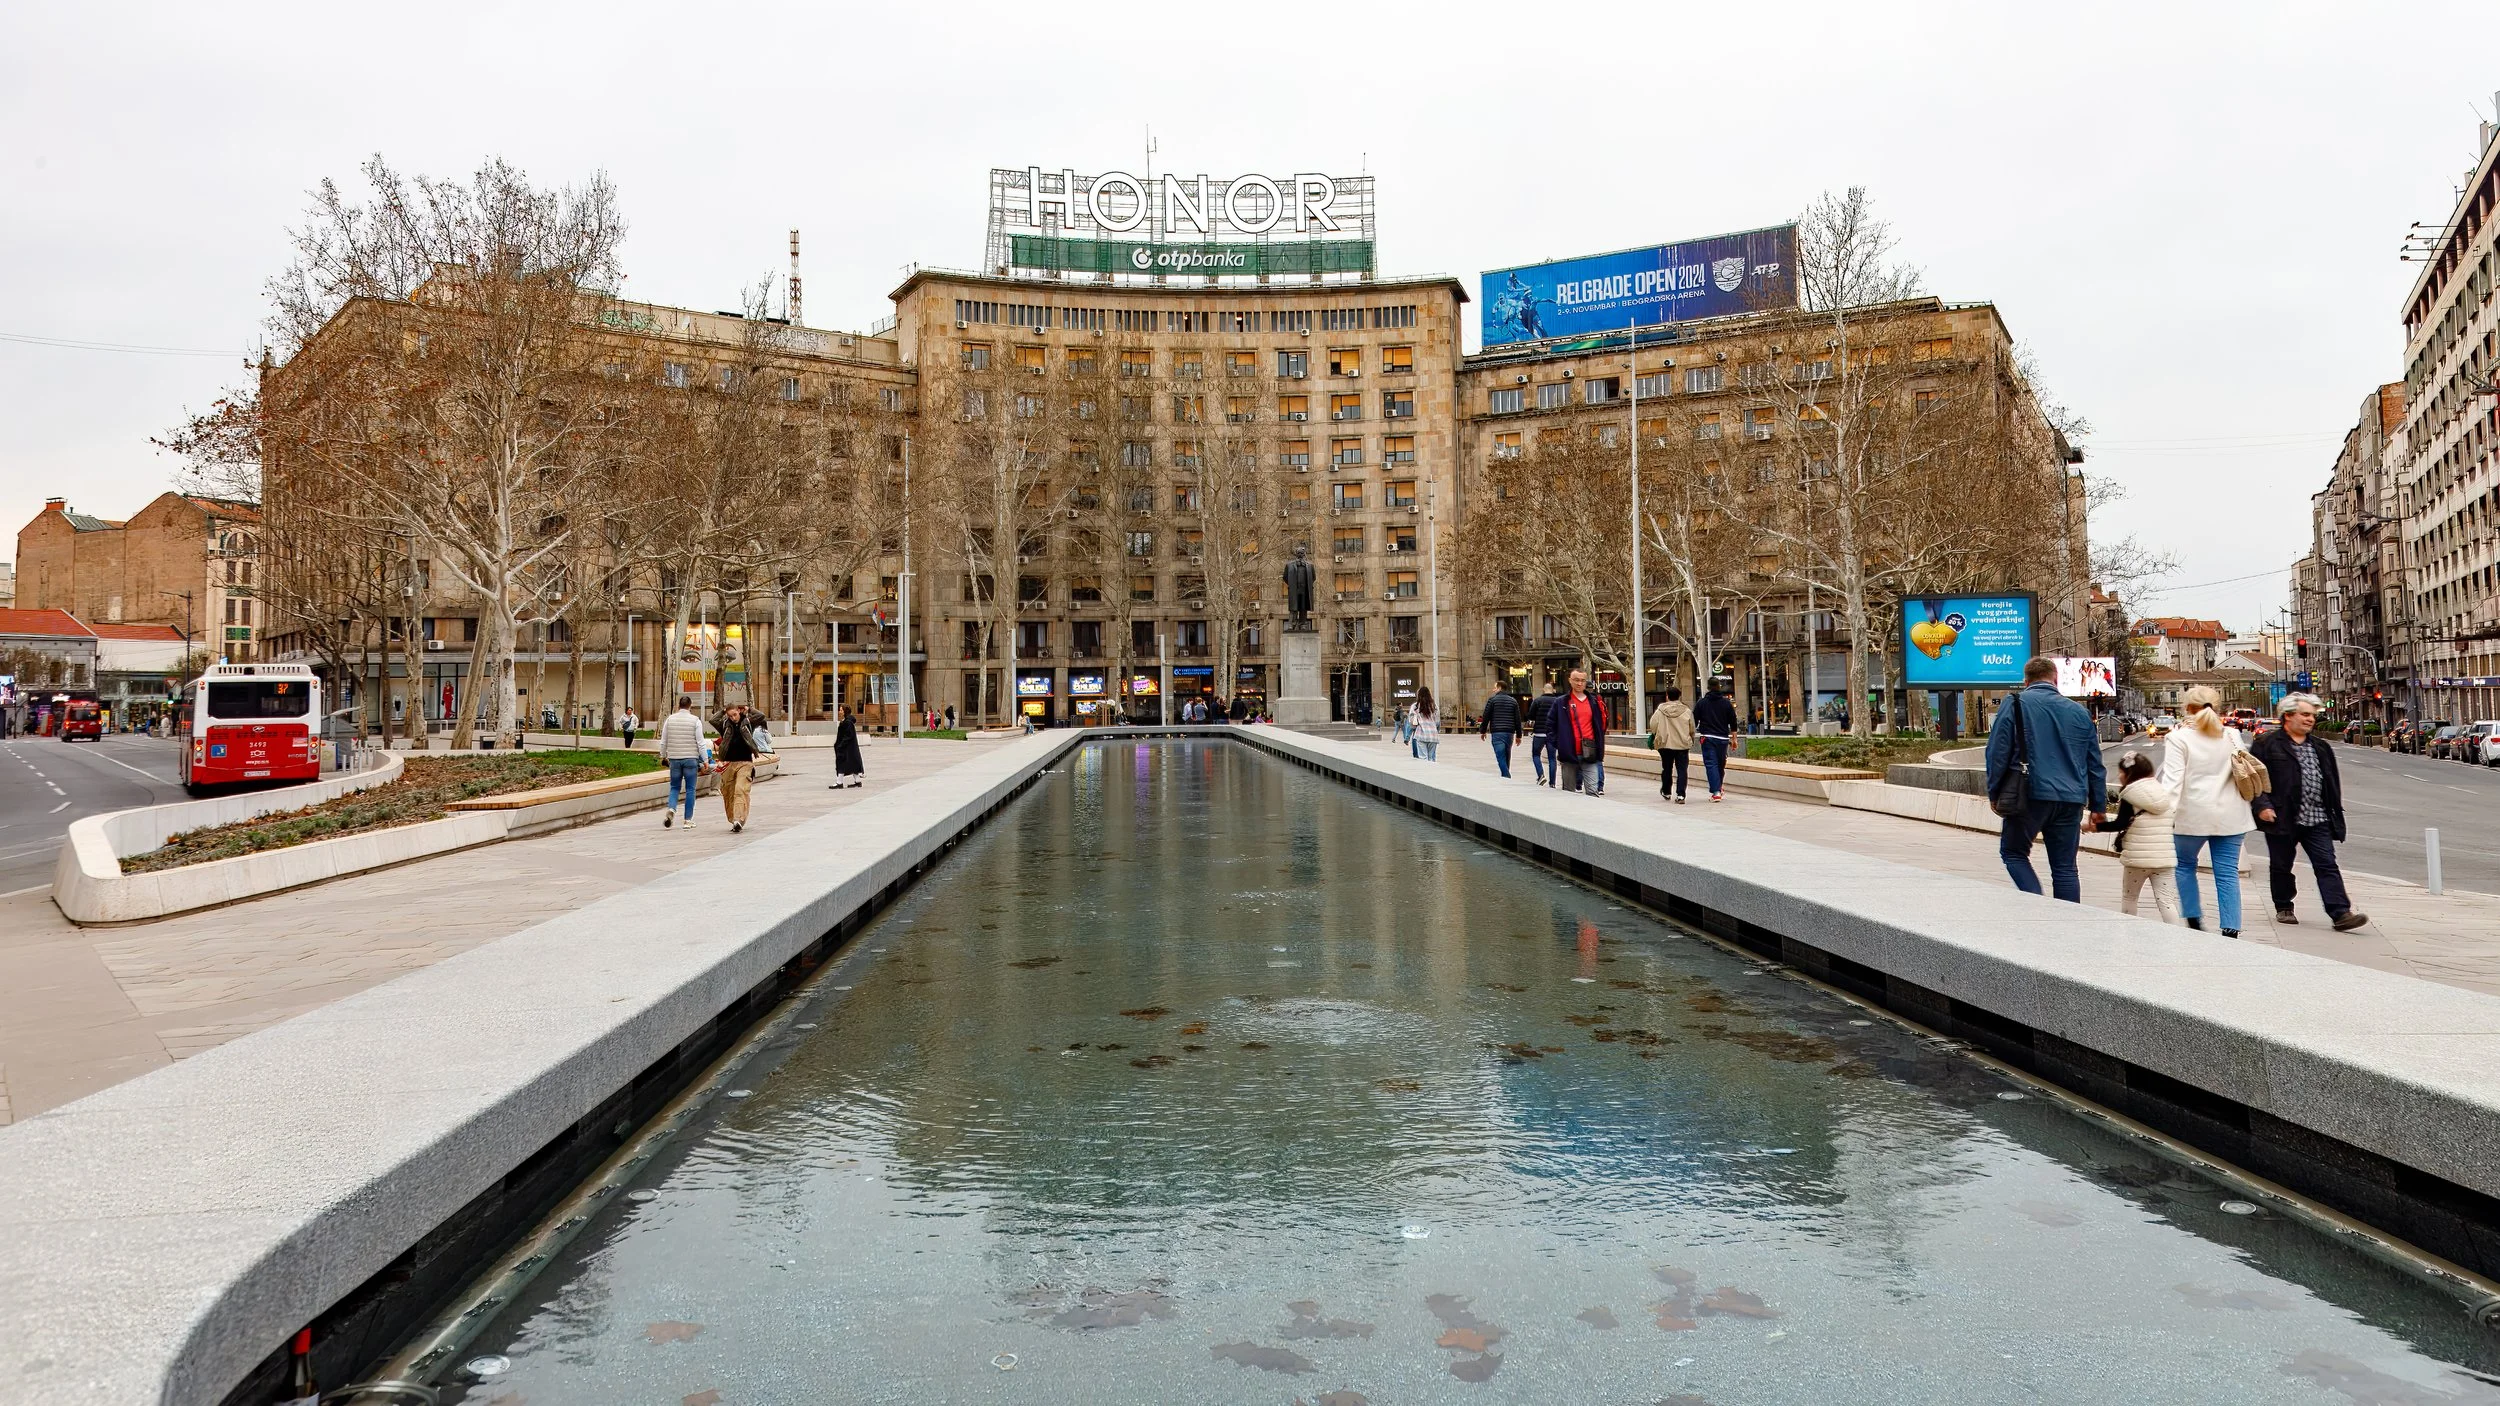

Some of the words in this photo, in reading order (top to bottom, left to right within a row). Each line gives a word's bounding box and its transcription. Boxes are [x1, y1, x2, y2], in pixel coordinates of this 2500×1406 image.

[1028, 166, 1341, 233] HONOR
[1751, 262, 1780, 276] ATP
[1556, 273, 1632, 307] BELGRADE
[1634, 268, 1677, 295] OPEN
[1678, 263, 1706, 290] 2024
[1572, 301, 1617, 314] NOVEMBAR
[1621, 293, 1677, 307] BEOGRADSKA
[1678, 289, 1706, 301] ARENA
[1982, 653, 2013, 665] Wolt
